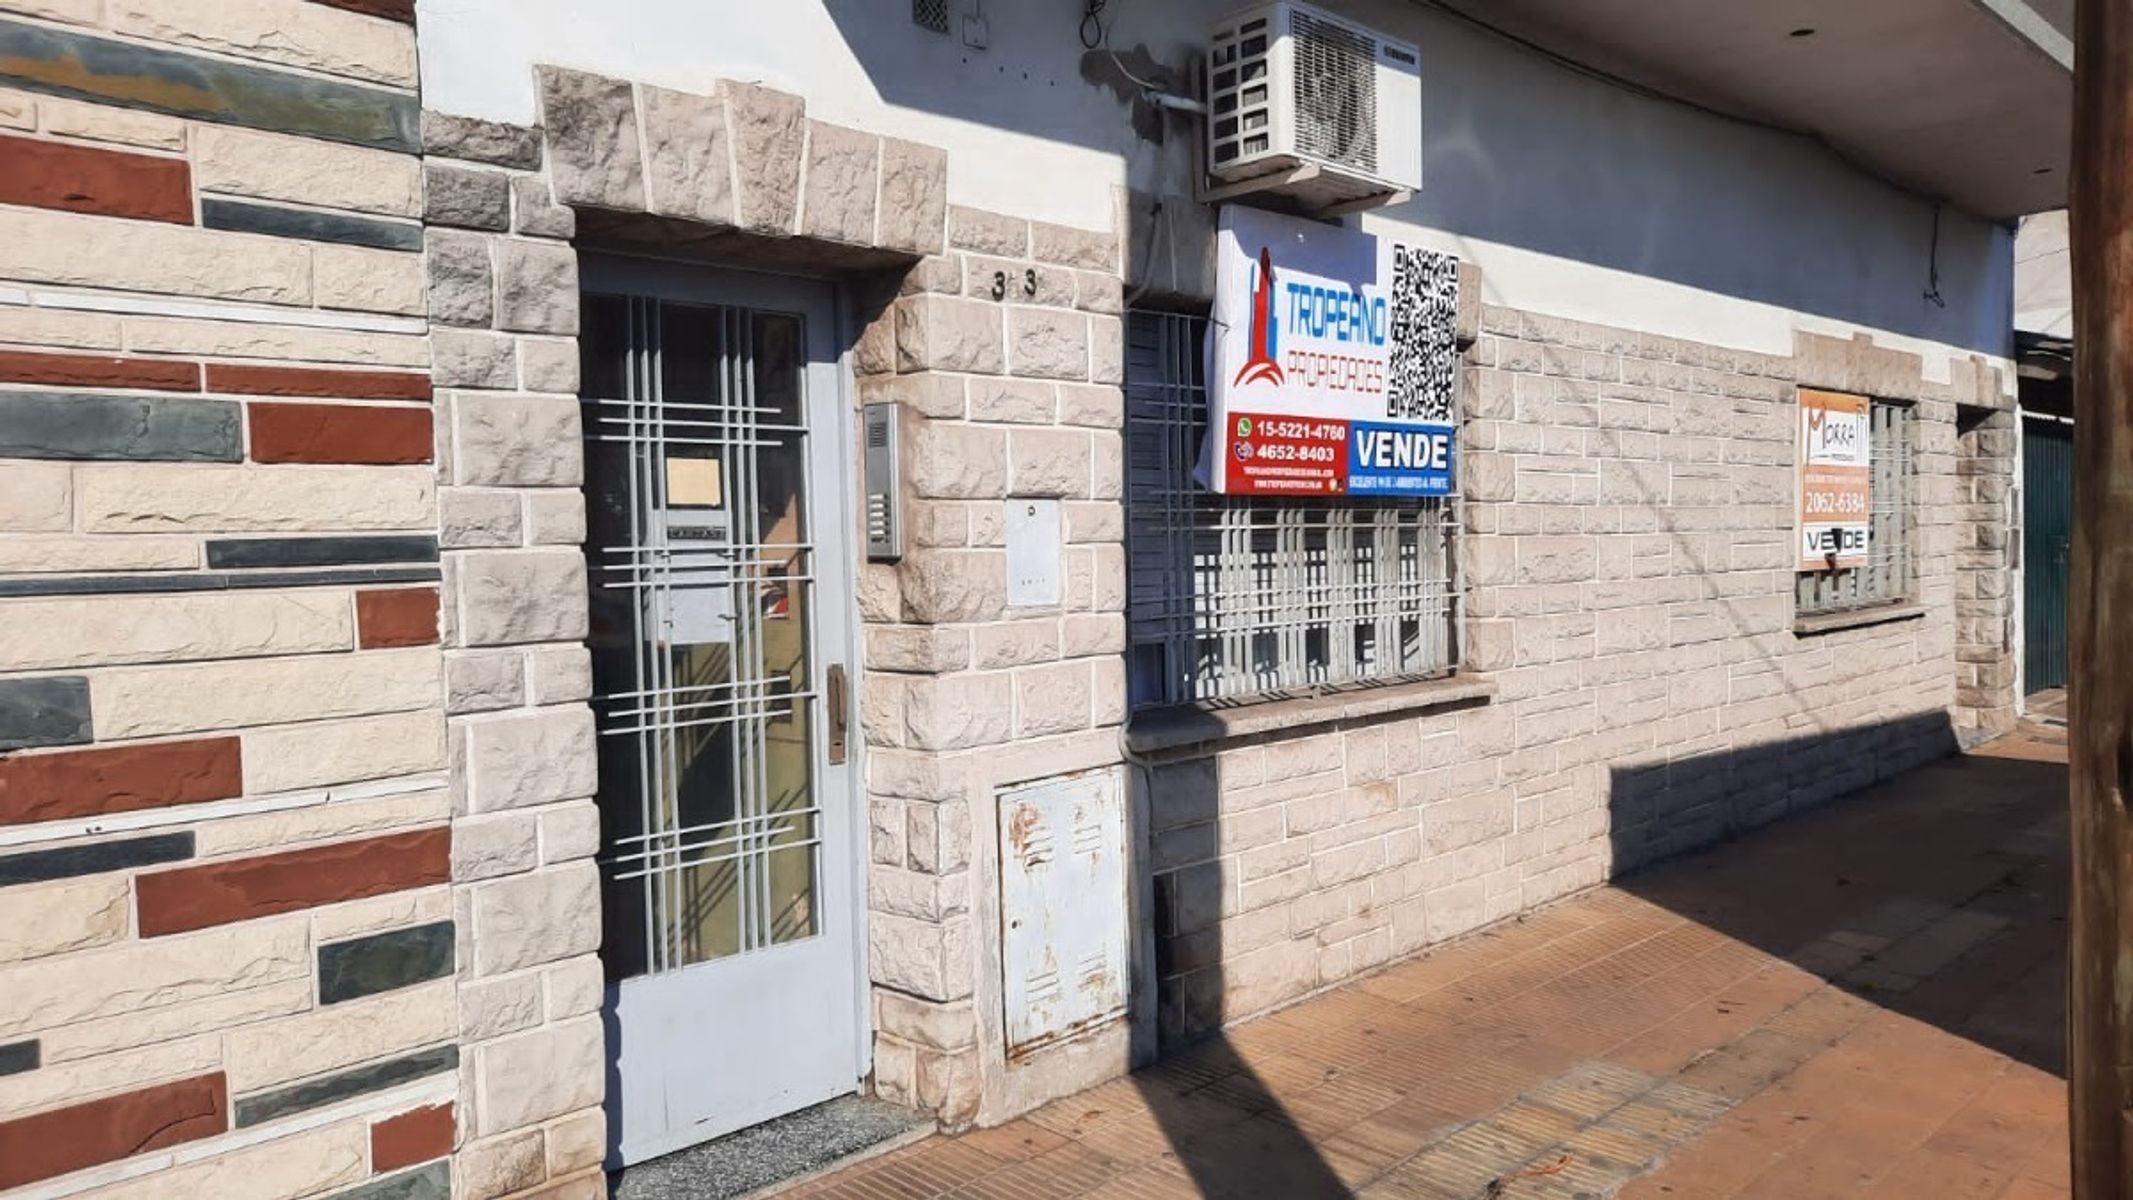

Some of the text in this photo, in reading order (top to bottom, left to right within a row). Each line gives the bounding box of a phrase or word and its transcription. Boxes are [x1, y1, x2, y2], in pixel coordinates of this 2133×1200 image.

[1287, 282, 1386, 346] TROPEANO
[1287, 350, 1383, 393] PROPIEDADES
[1257, 420, 1346, 441] 15-5221-4760
[1257, 444, 1335, 461] 4652-8403
[1356, 430, 1449, 469] VENDE
[1807, 530, 1864, 550] VEDE
